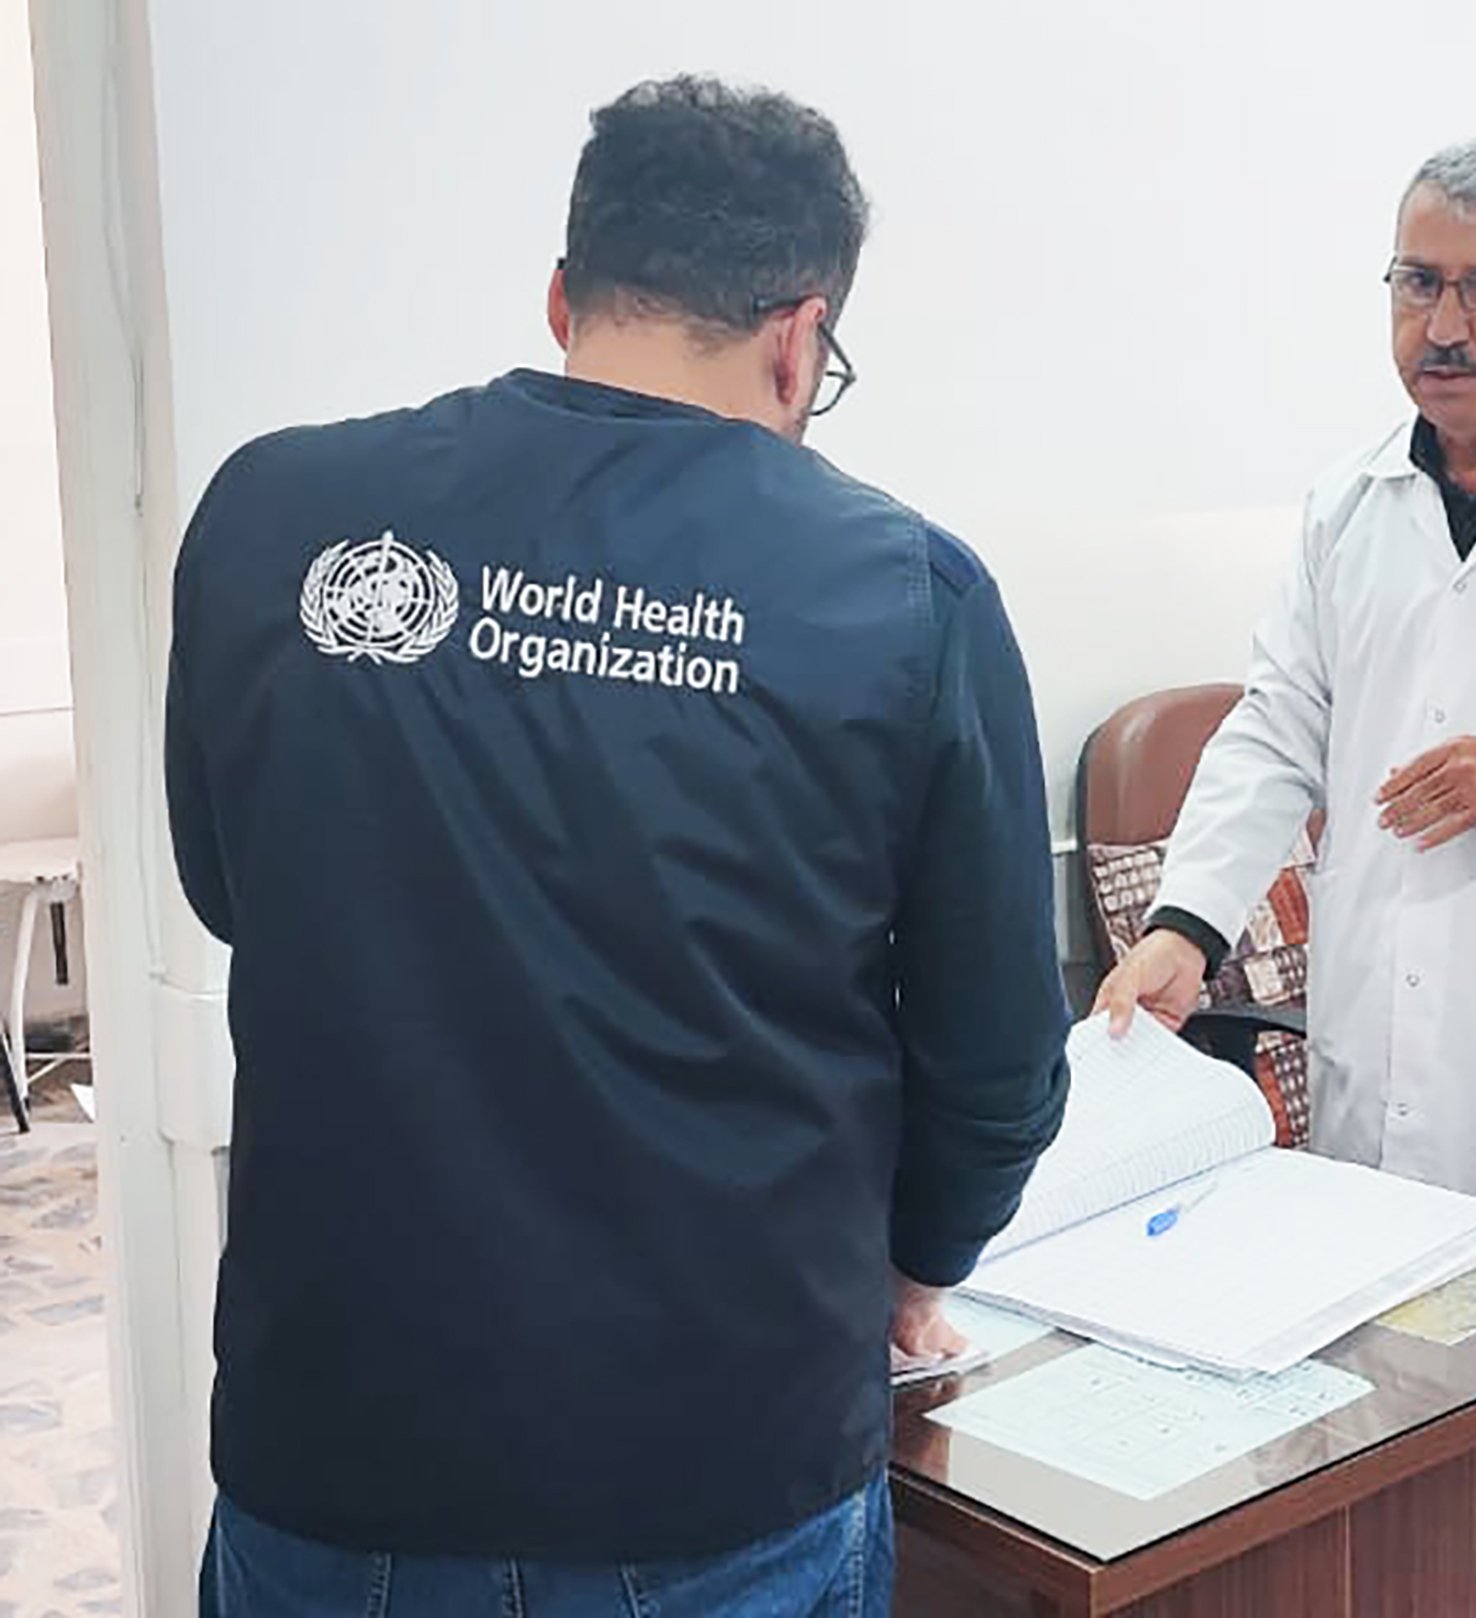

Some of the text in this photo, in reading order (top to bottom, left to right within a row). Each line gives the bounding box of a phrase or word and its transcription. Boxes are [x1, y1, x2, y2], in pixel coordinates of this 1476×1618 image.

[482, 565, 744, 644] World Health
[469, 617, 738, 693] Organization
